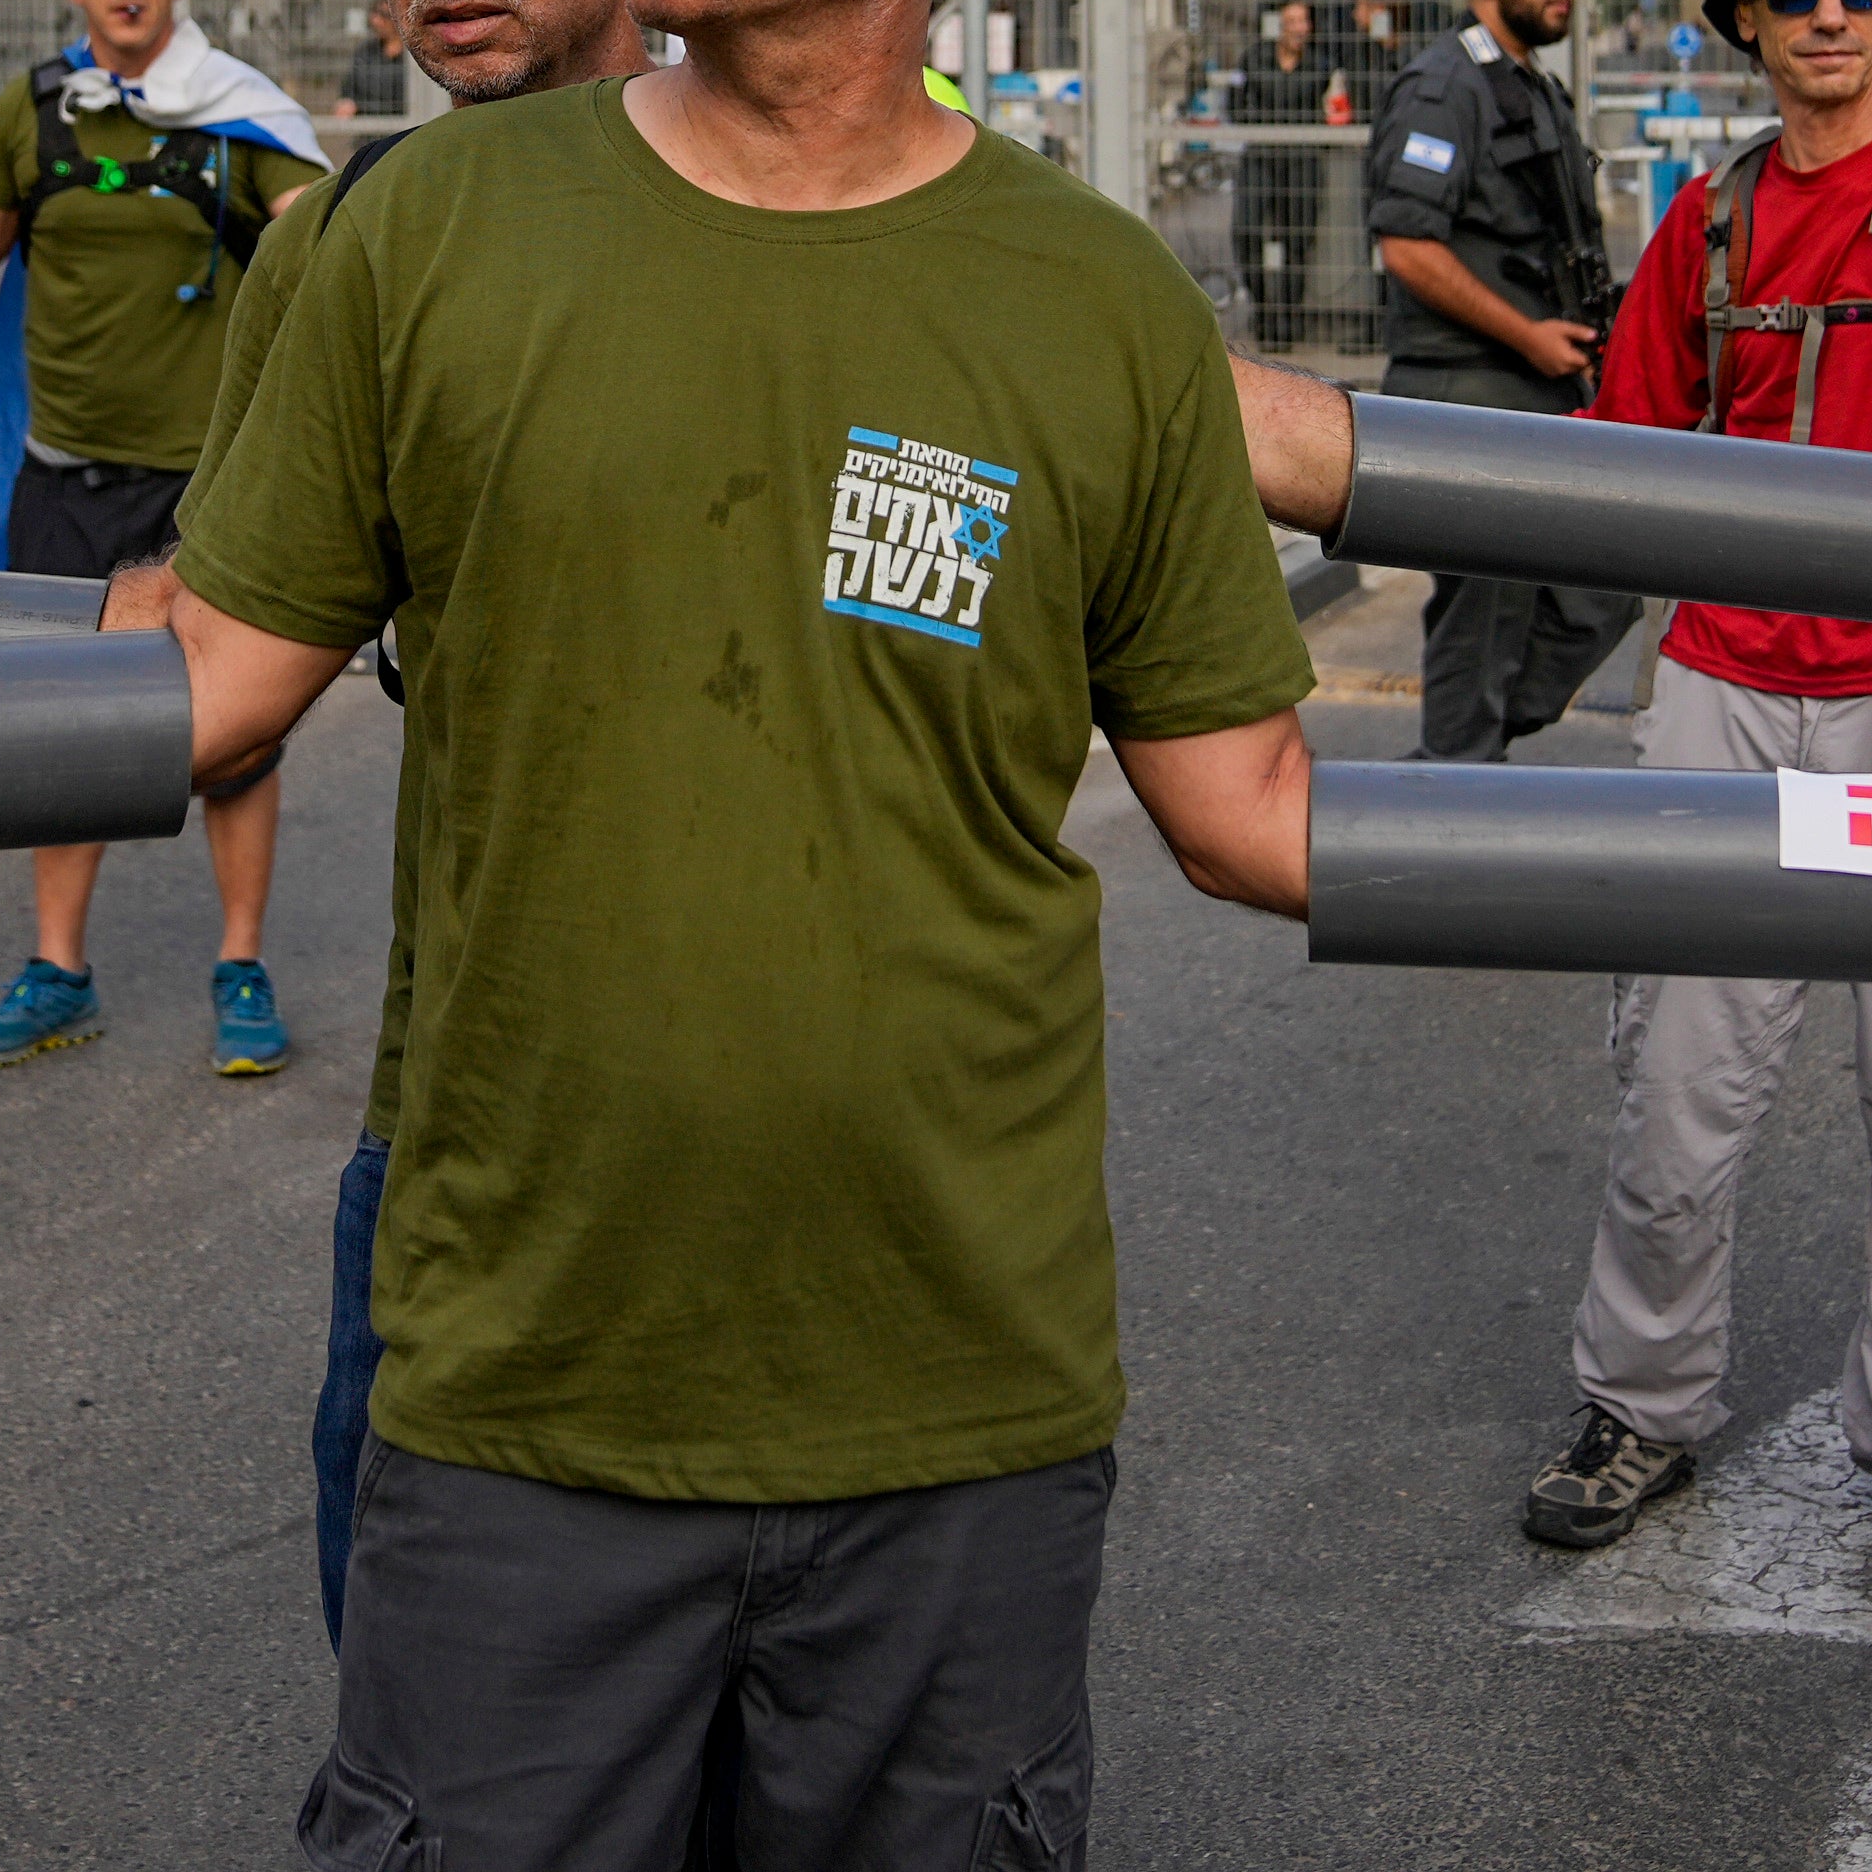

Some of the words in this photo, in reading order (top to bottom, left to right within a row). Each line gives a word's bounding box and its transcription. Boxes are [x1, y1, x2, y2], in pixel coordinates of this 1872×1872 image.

[844, 448, 1011, 514] המילואימניקים
[897, 438, 971, 476] מחאת
[830, 473, 964, 560] אחים
[822, 531, 994, 627] לנשק
